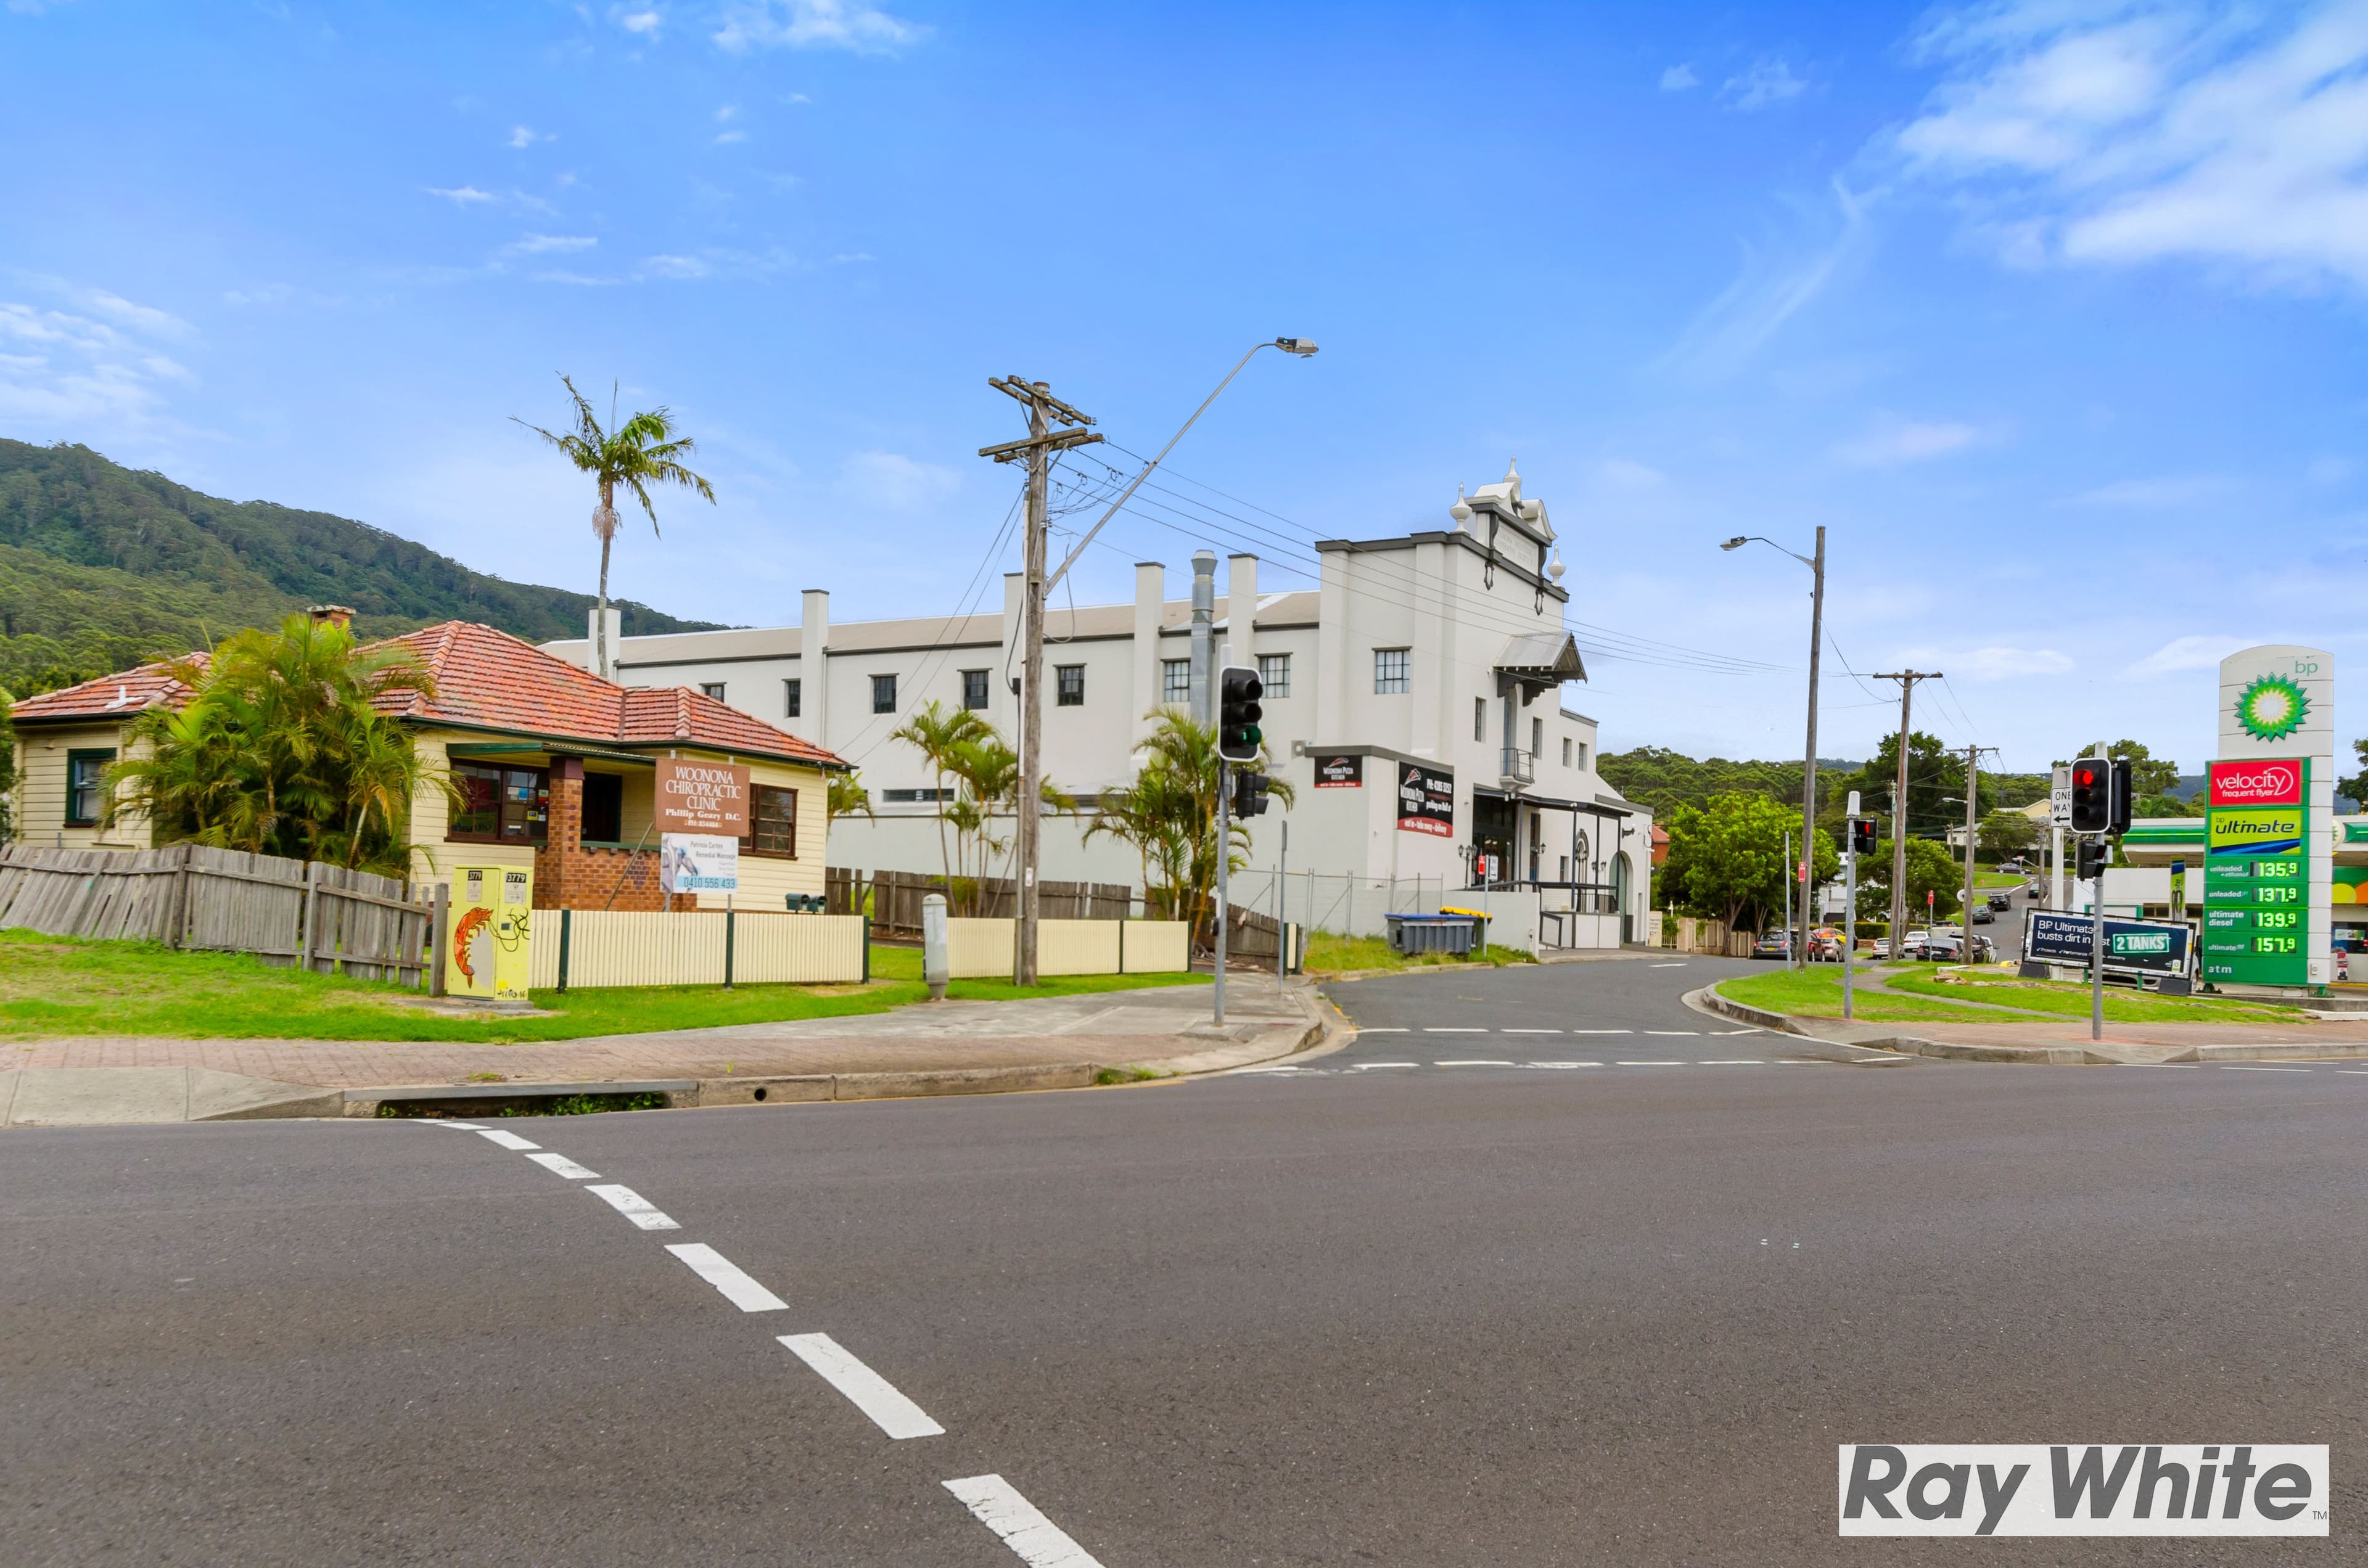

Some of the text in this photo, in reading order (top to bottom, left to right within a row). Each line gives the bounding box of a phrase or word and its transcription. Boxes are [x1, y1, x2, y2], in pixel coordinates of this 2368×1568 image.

[2295, 660, 2318, 676] bp
[675, 766, 734, 784] WOONONA
[665, 779, 742, 799] CHIROPRACTIC
[2216, 773, 2285, 795] velocity
[2222, 789, 2274, 797] frequent flyer
[687, 795, 721, 811] CLINIC
[665, 808, 741, 821] Phillip Geary D.C.
[2216, 819, 2295, 834] ultimate
[469, 871, 525, 882] 3779 3779
[2259, 862, 2297, 877] 135.9
[684, 877, 736, 889] 0410 556 433
[2258, 887, 2296, 902] 137.9
[2039, 921, 2094, 934] BP Ultimate
[2258, 913, 2296, 927] 139.9
[2037, 930, 2063, 942] busts
[2065, 933, 2081, 943] dirt
[2082, 935, 2090, 944] in
[2116, 937, 2125, 950] 2
[2128, 936, 2165, 950] TANKS
[2257, 937, 2295, 952] 157.9
[2208, 965, 2232, 974] atm
